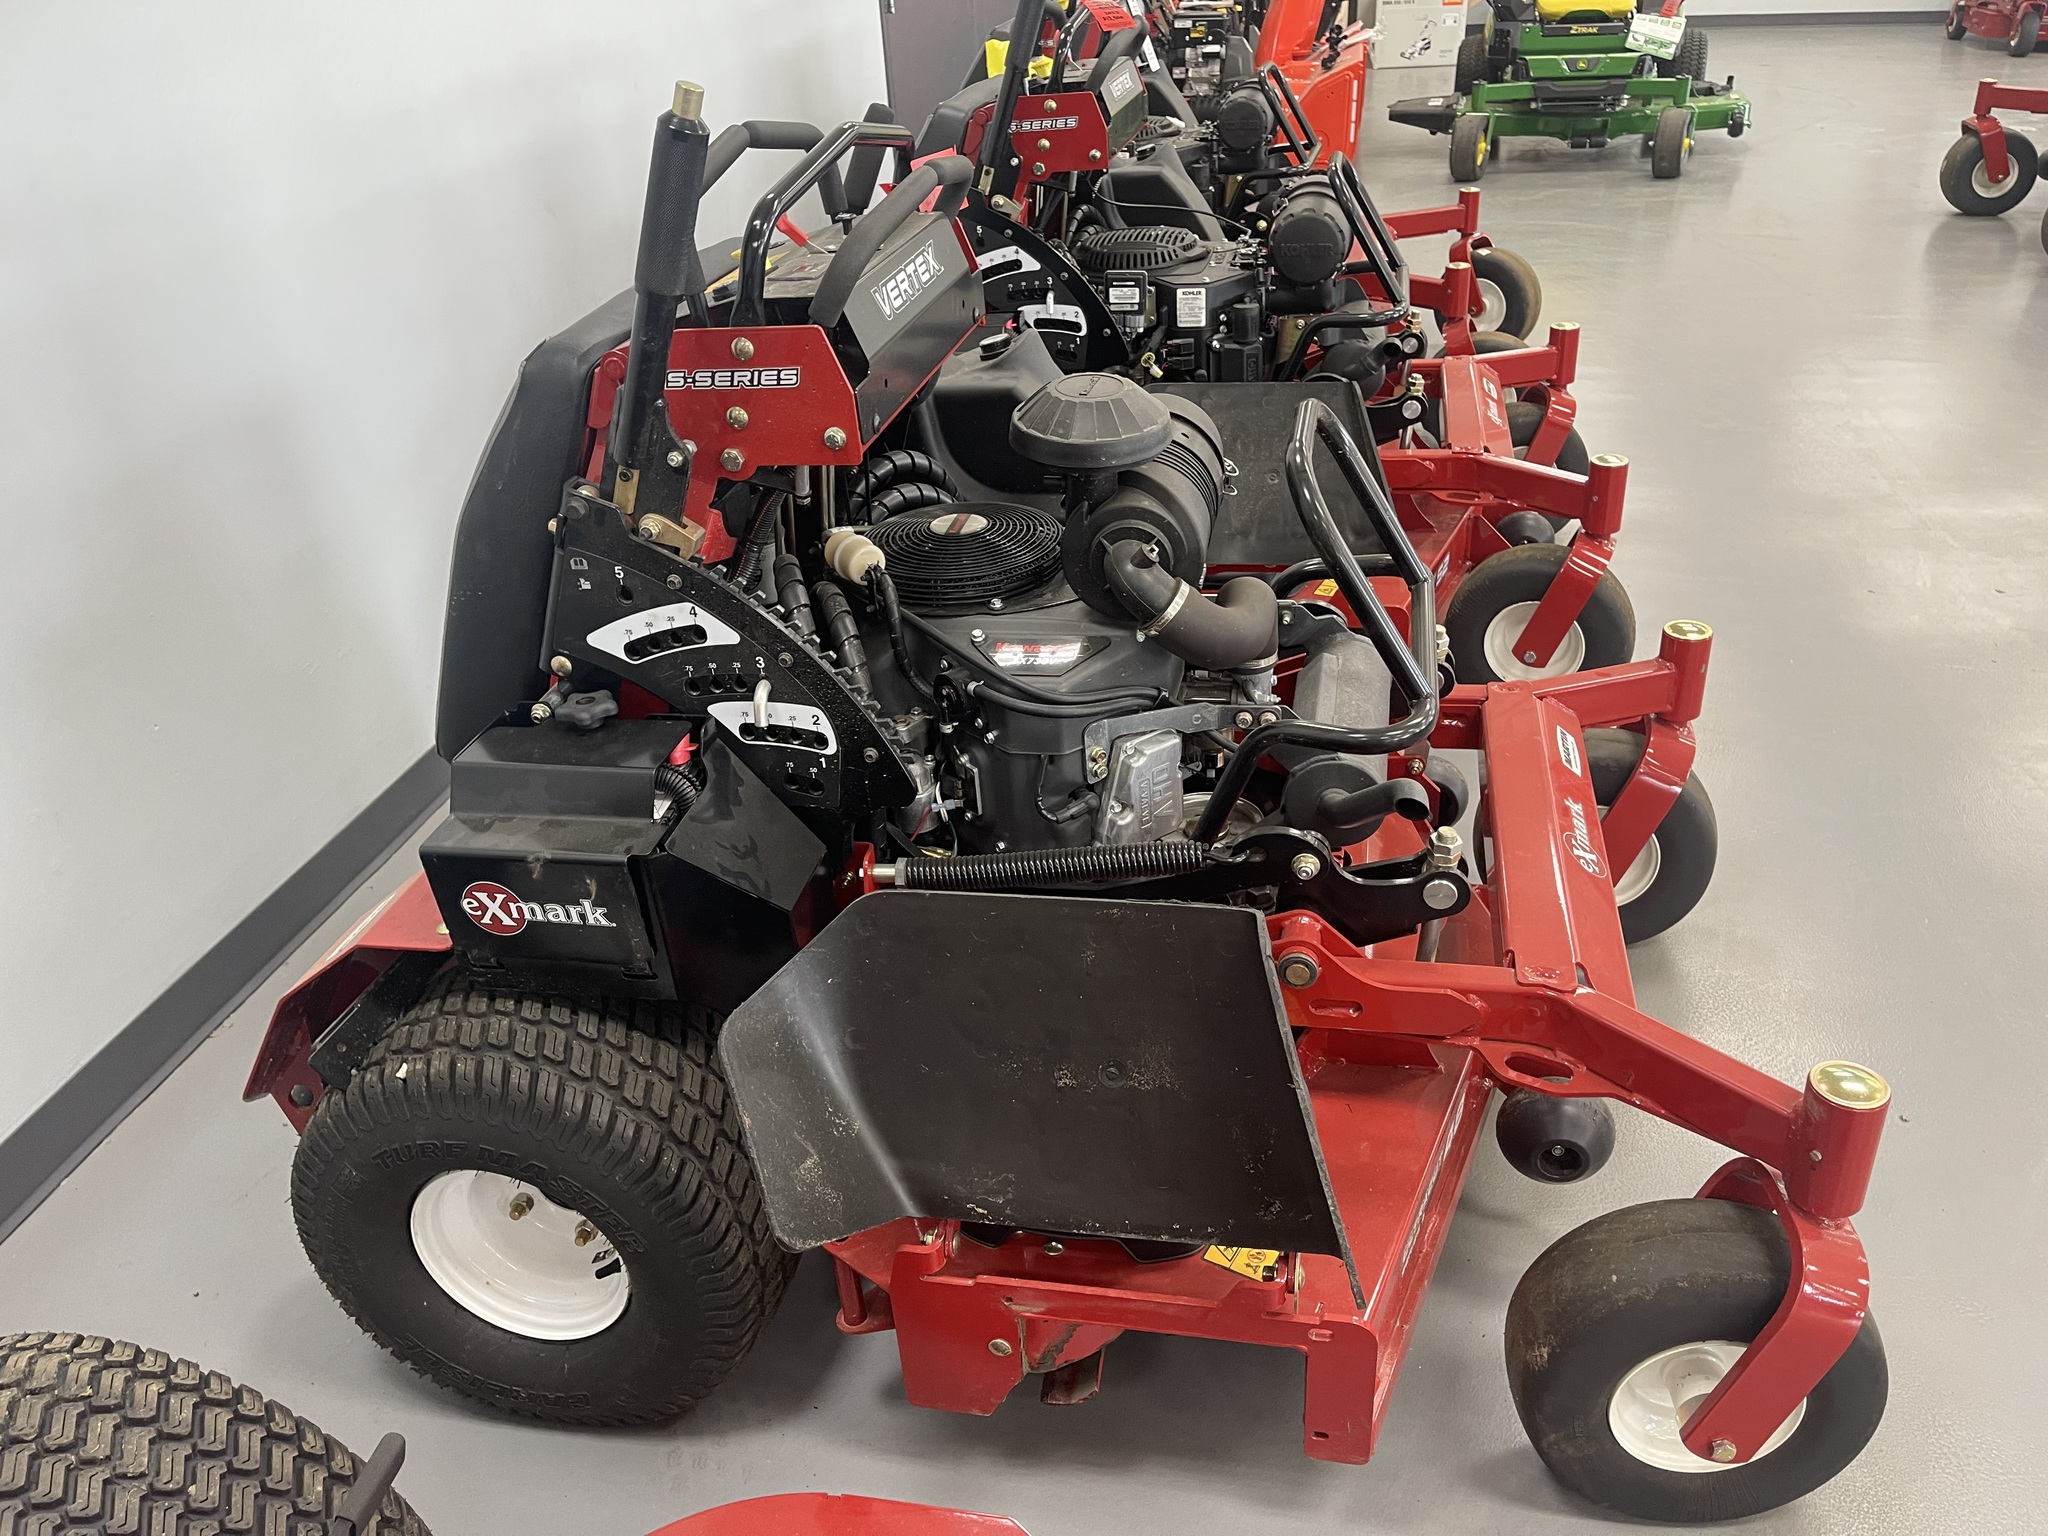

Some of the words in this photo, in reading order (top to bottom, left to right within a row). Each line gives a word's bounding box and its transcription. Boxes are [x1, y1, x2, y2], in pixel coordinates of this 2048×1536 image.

[1009, 117, 1078, 133] S-SERIES
[976, 225, 983, 234] 5
[872, 242, 943, 319] VERTEX
[1046, 276, 1054, 285] 3
[1074, 311, 1080, 319] 2
[1075, 337, 1081, 345] 1
[665, 367, 800, 389] S-SERIES
[614, 565, 625, 579] 5
[689, 606, 698, 618] 4
[755, 656, 765, 669] 3
[811, 714, 821, 726] 2
[819, 756, 827, 769] 1
[1151, 762, 1174, 817] OHV
[1564, 796, 1601, 875] eXmark
[462, 891, 615, 927] eXmark
[371, 1140, 468, 1172] TURF
[479, 1144, 648, 1253] MASTER
